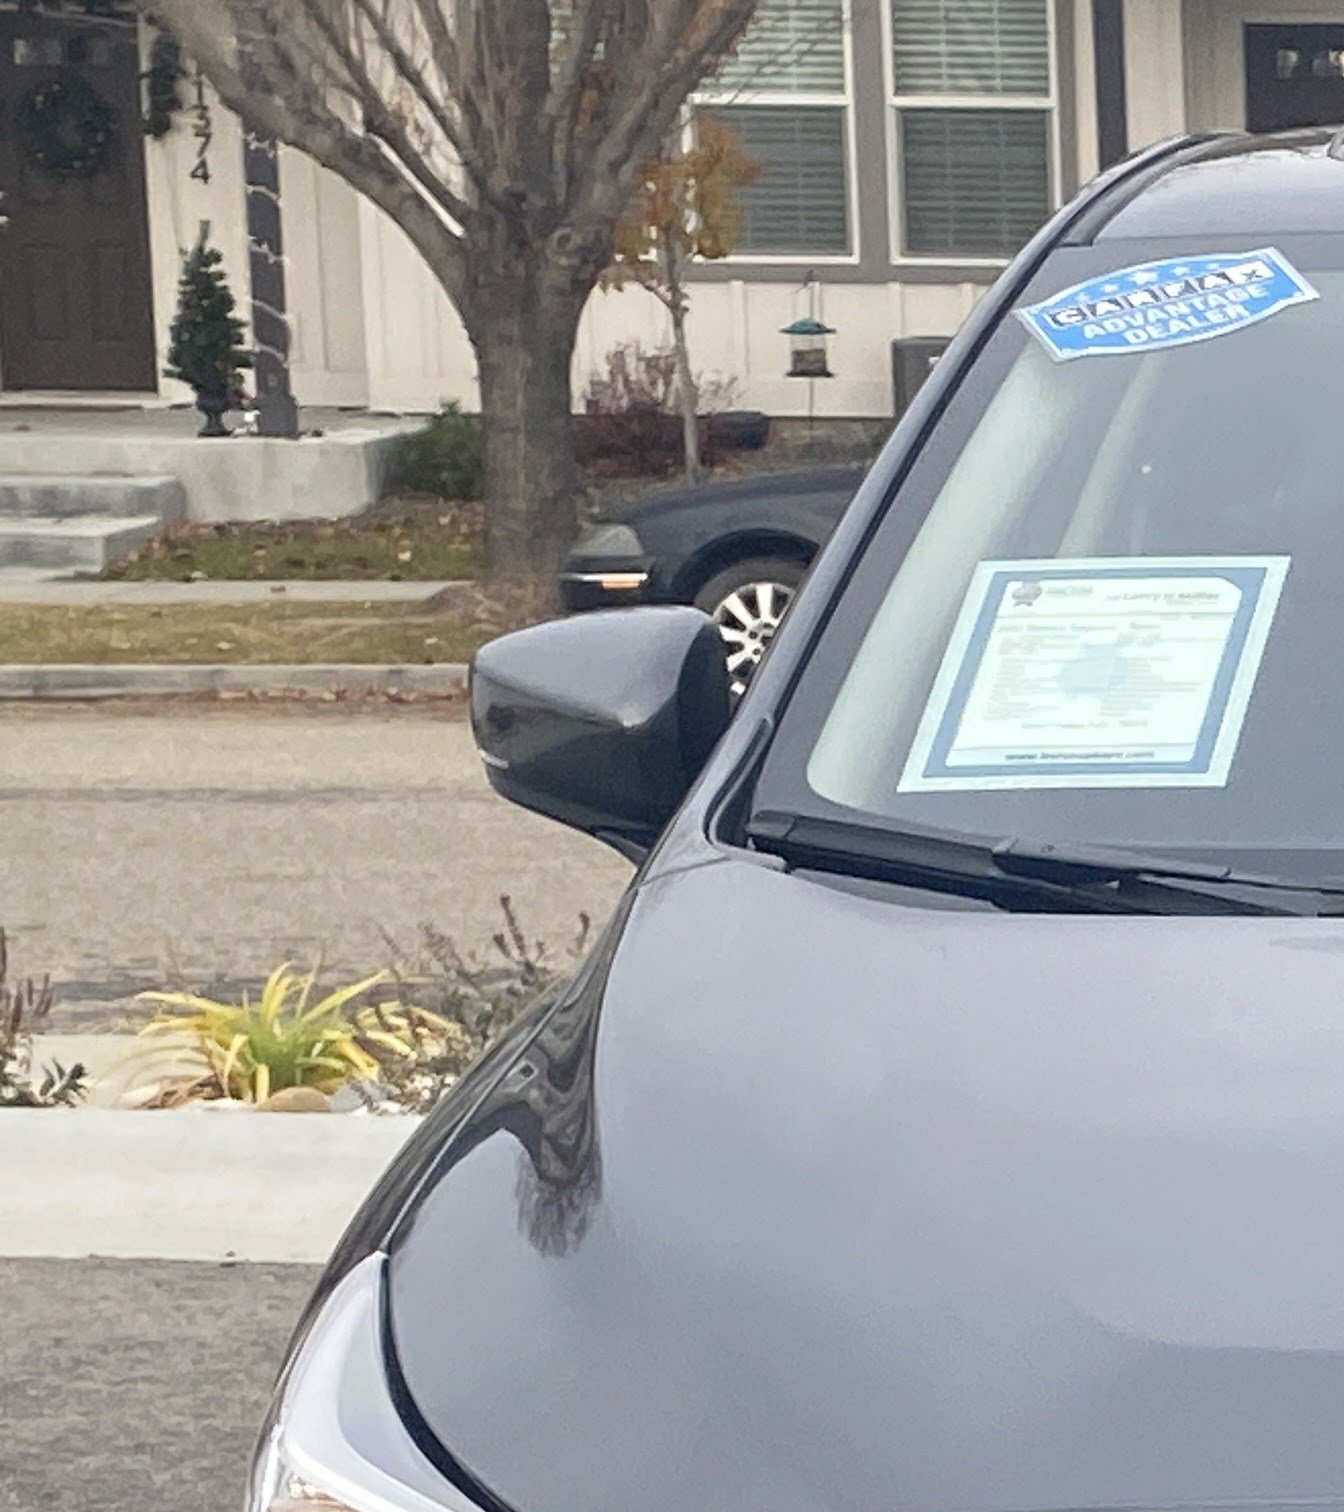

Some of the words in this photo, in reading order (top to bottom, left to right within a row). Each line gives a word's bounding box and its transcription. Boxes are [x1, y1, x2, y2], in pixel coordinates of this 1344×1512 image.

[1050, 262, 1272, 328] CARFAX
[1083, 281, 1268, 339] ADVANTAGE
[1122, 302, 1250, 345] DEALER
